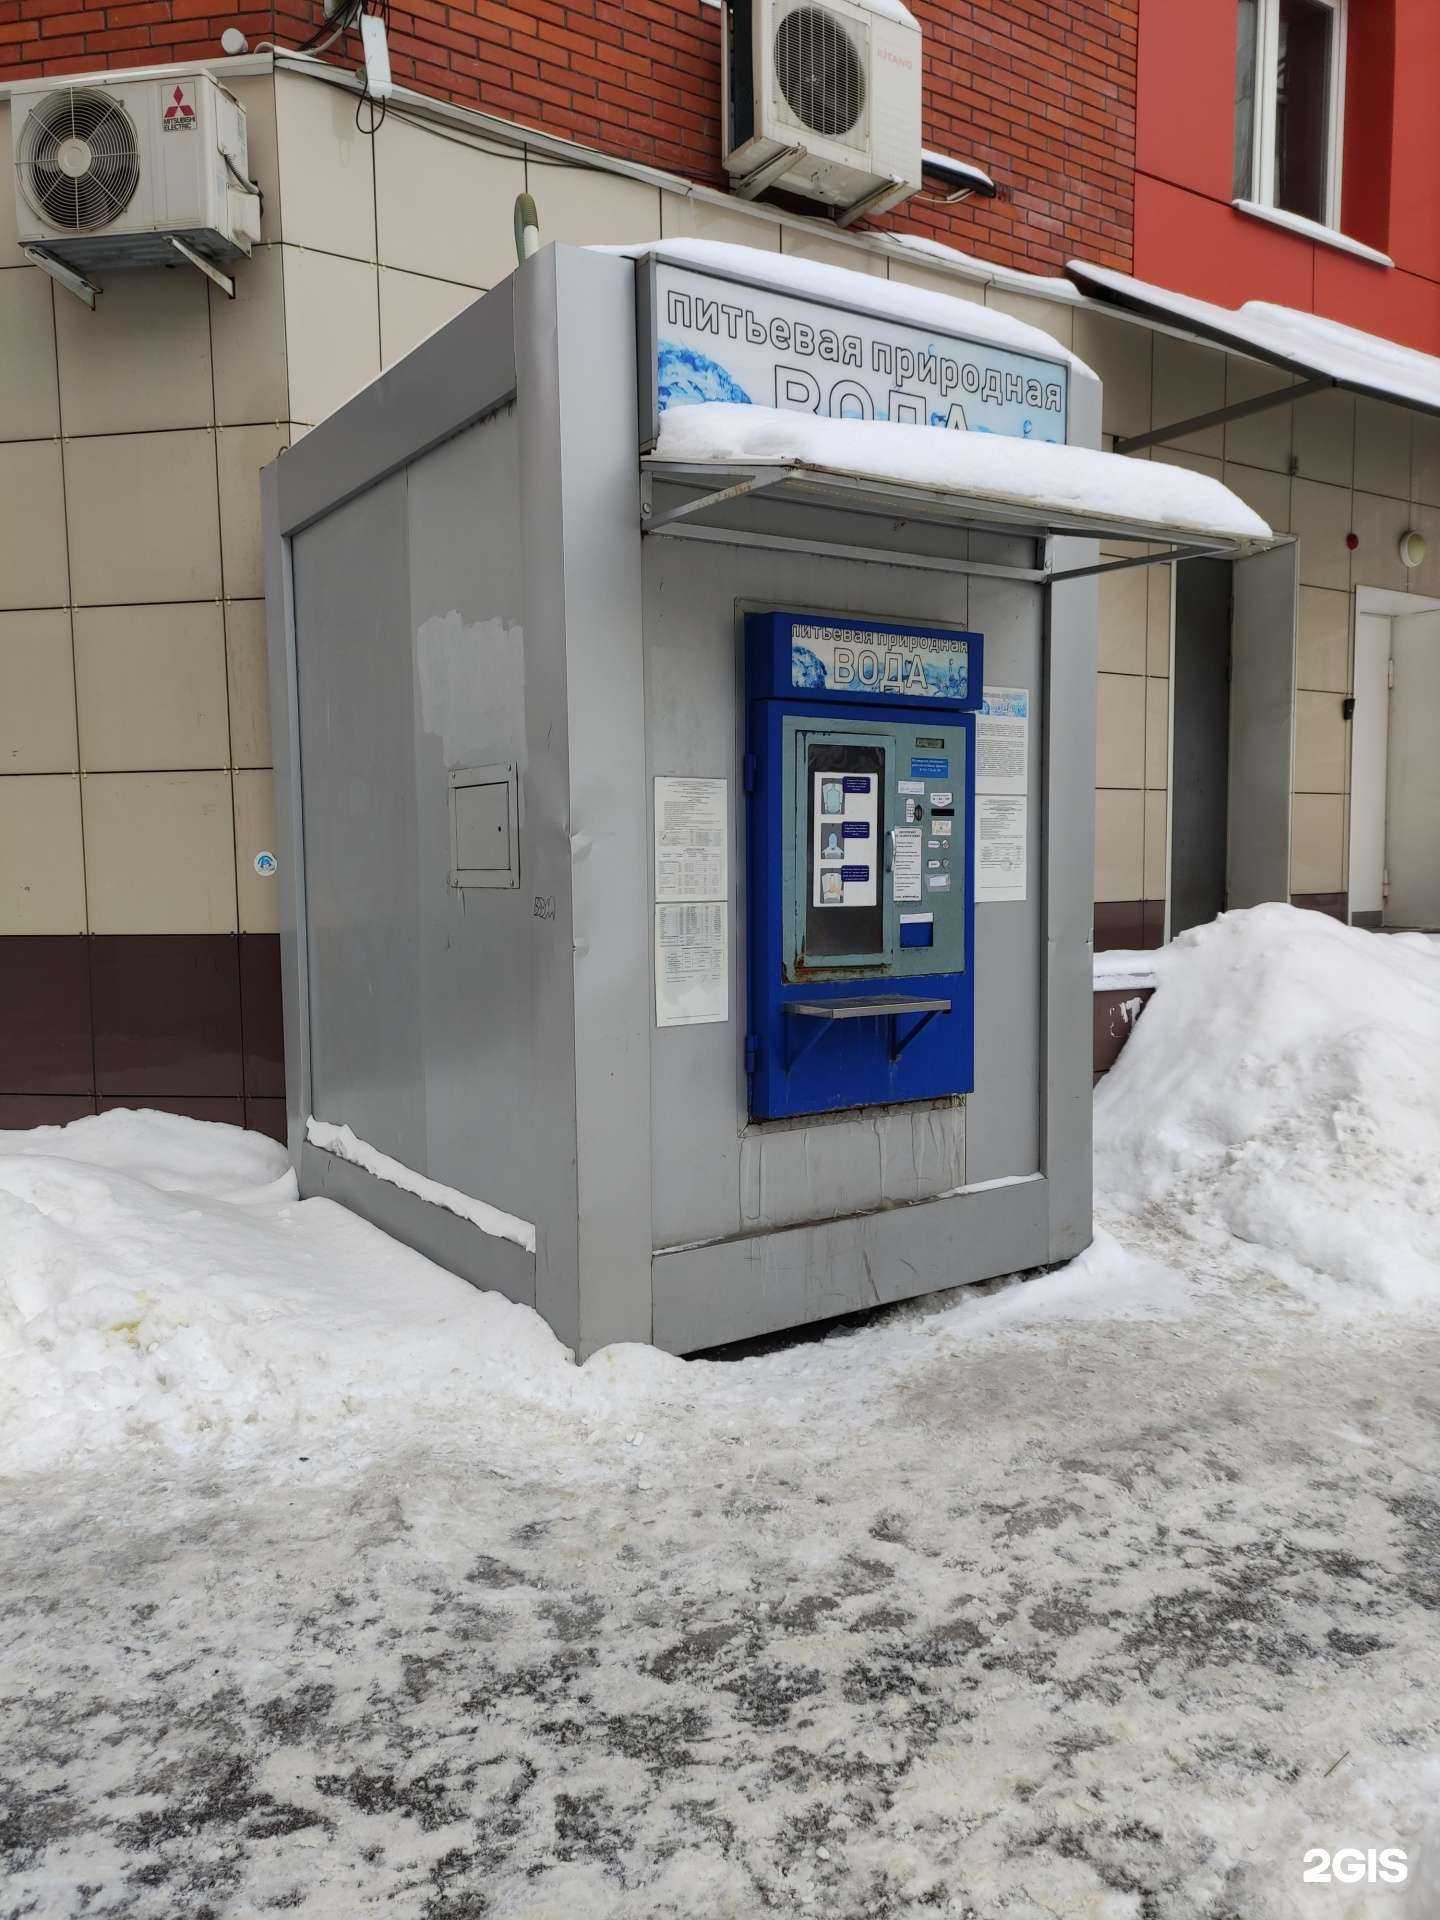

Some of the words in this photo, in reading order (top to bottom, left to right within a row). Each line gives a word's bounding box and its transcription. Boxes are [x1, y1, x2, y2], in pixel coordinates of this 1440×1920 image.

[163, 123, 192, 131] ELECTRIC
[667, 290, 864, 368] питьевая
[872, 341, 1063, 413] природная
[791, 623, 874, 645] питьевая
[877, 632, 968, 653] природная
[833, 647, 928, 694] ВОДА
